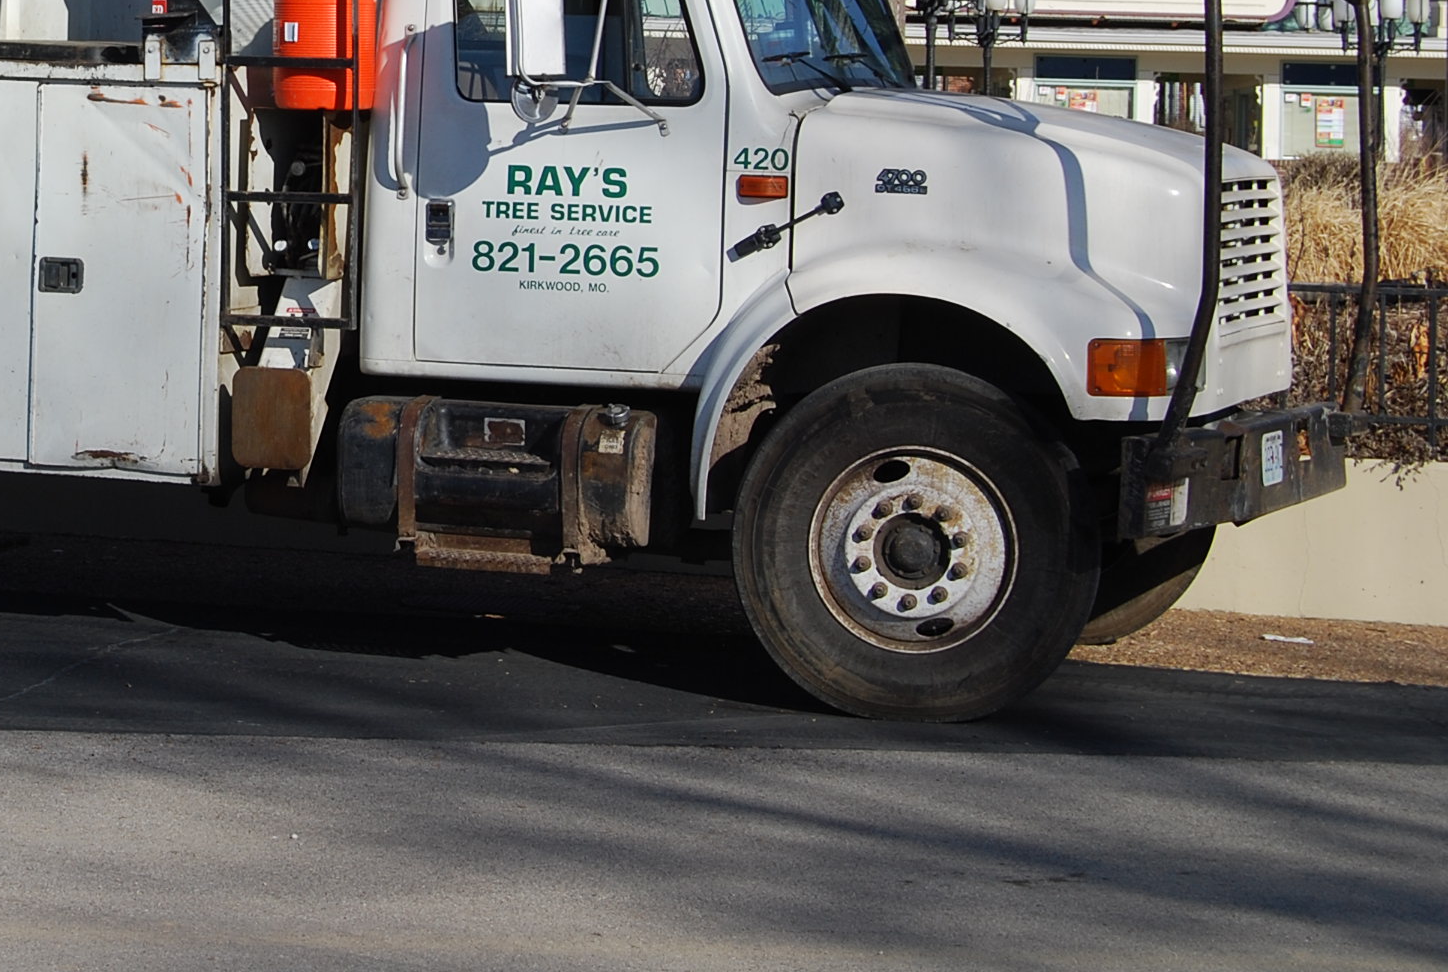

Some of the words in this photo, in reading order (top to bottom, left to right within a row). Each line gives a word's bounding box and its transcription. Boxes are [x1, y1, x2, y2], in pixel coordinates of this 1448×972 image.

[734, 147, 789, 171] 420
[506, 164, 629, 200] RAY'S
[876, 168, 927, 186] 4700
[482, 200, 540, 220] TREE
[550, 202, 653, 224] SERVICE
[511, 224, 546, 236] finest
[551, 227, 562, 235] in
[569, 226, 593, 236] tree
[596, 229, 620, 237] care
[471, 240, 661, 279] 821-2665
[519, 280, 584, 293] KIRKWOOD,
[588, 282, 610, 293] MO.
